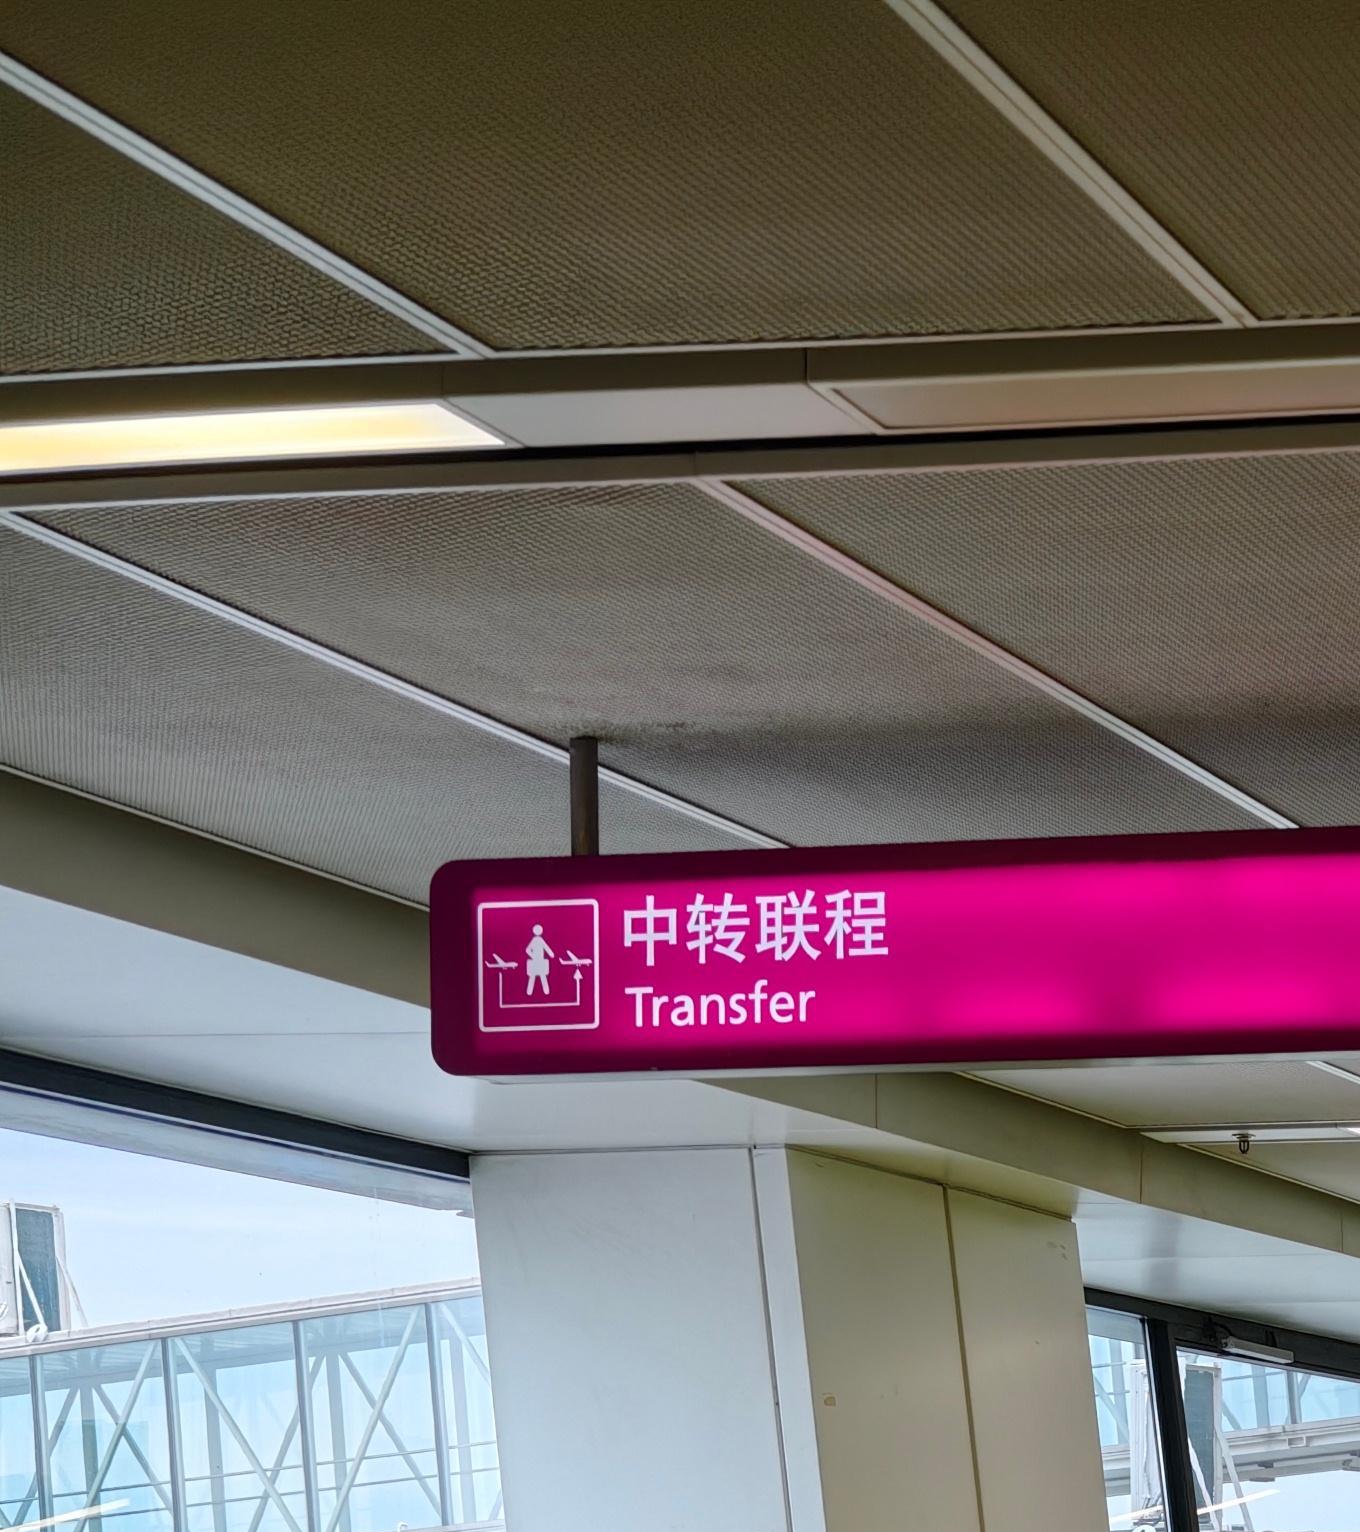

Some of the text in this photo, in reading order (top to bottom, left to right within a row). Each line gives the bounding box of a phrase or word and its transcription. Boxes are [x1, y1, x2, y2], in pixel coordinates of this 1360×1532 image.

[623, 889, 889, 966] 中转联程
[624, 980, 816, 1028] Transfer
